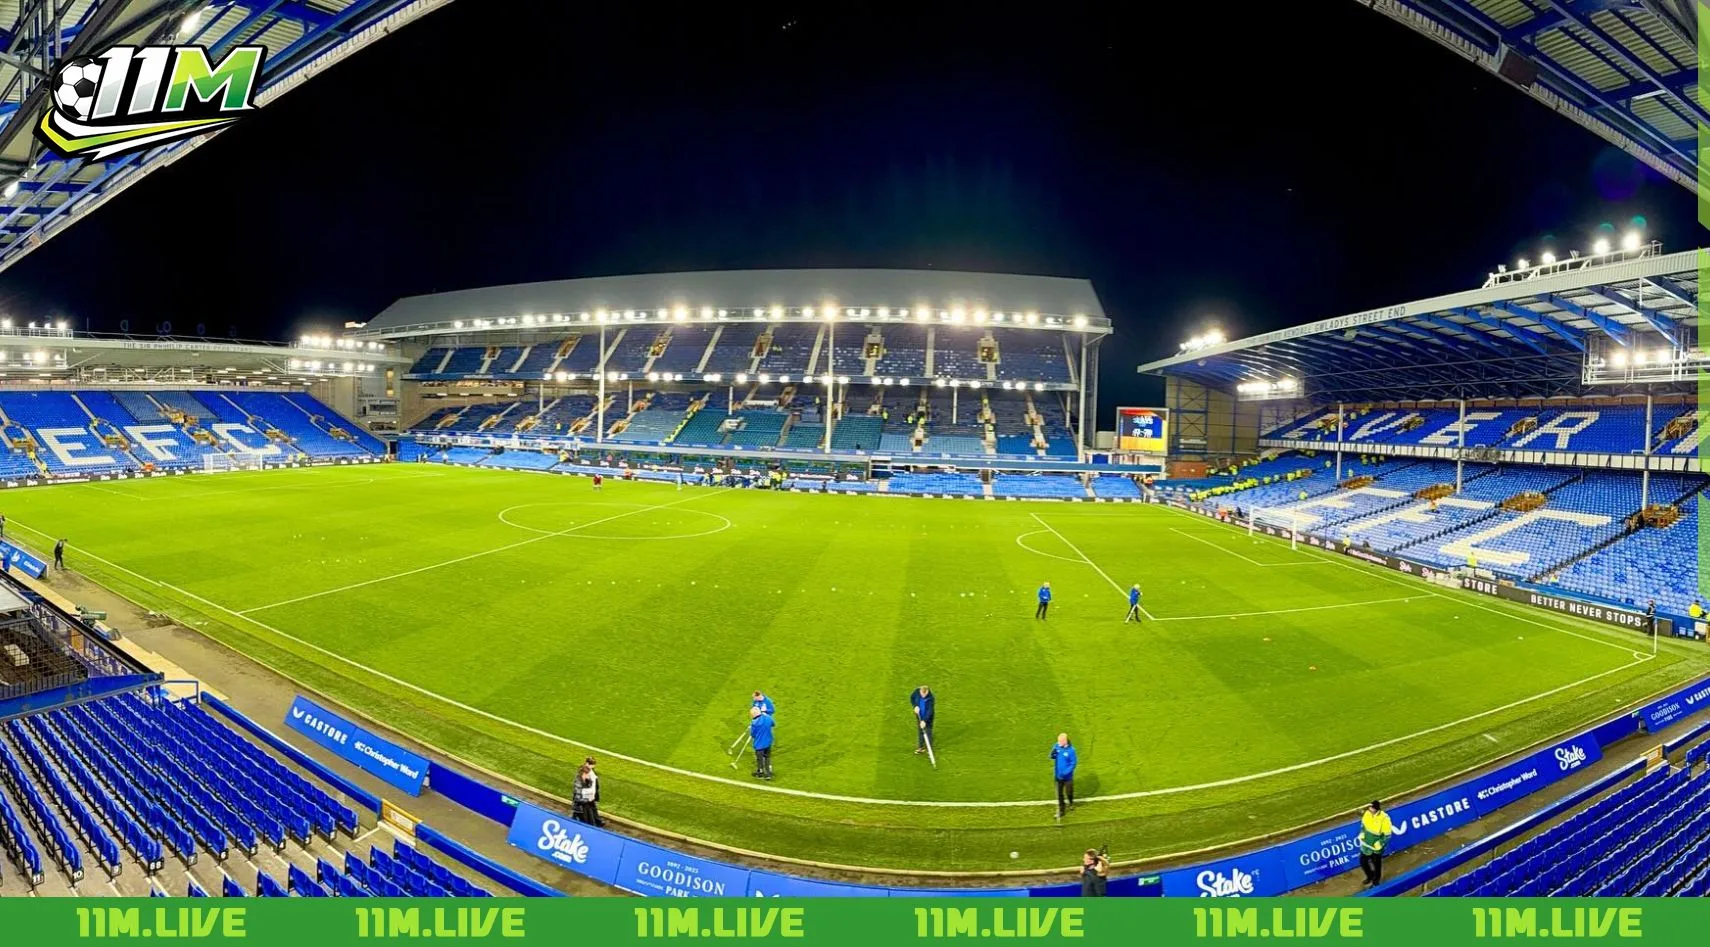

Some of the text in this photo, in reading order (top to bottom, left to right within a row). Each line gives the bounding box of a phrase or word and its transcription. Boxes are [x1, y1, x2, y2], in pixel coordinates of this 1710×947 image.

[1352, 310, 1384, 325] STREET
[1388, 305, 1406, 319] END
[1464, 578, 1498, 596] STORE
[1531, 594, 1642, 627] BETTER NEVER STOPS
[304, 714, 348, 745] CASTORE
[1554, 745, 1586, 771] Stake
[1488, 775, 1521, 795] Christopher
[1411, 797, 1470, 829] CASTORE
[537, 819, 589, 864] Stake
[1300, 836, 1362, 866] GOODISO
[1329, 855, 1350, 869] PARK
[637, 861, 725, 896] GOODISON
[665, 885, 691, 897] PARK
[1196, 868, 1254, 897] Stake
